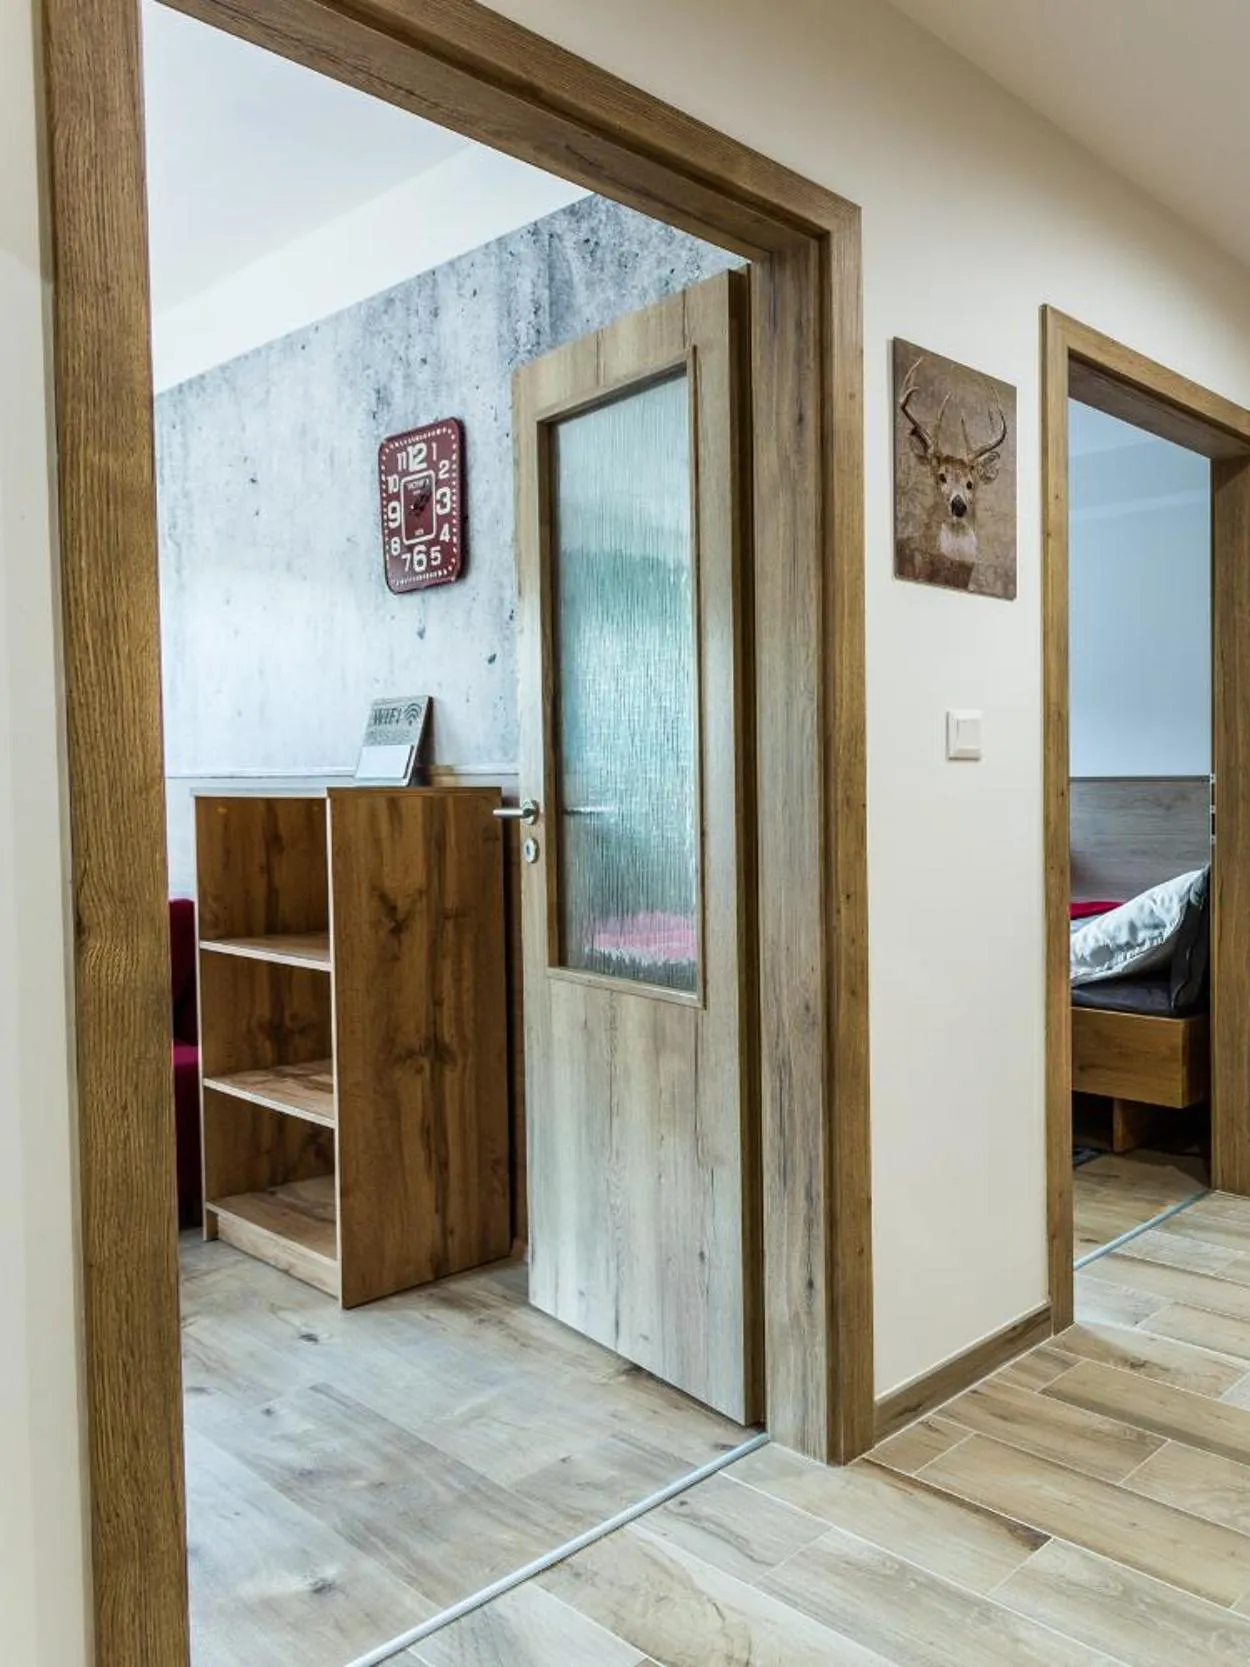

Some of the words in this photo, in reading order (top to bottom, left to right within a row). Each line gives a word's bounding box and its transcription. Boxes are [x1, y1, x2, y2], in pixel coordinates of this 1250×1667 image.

[397, 451, 407, 471] 11
[407, 442, 427, 472] 12
[439, 460, 450, 479] 2
[387, 474, 399, 494] 10
[436, 486, 451, 515] 3
[387, 501, 401, 529] 9
[440, 524, 450, 542] 4
[391, 537, 400, 556] 8
[430, 546, 441, 566] 5
[402, 553, 411, 573] 7
[413, 544, 428, 573] 6
